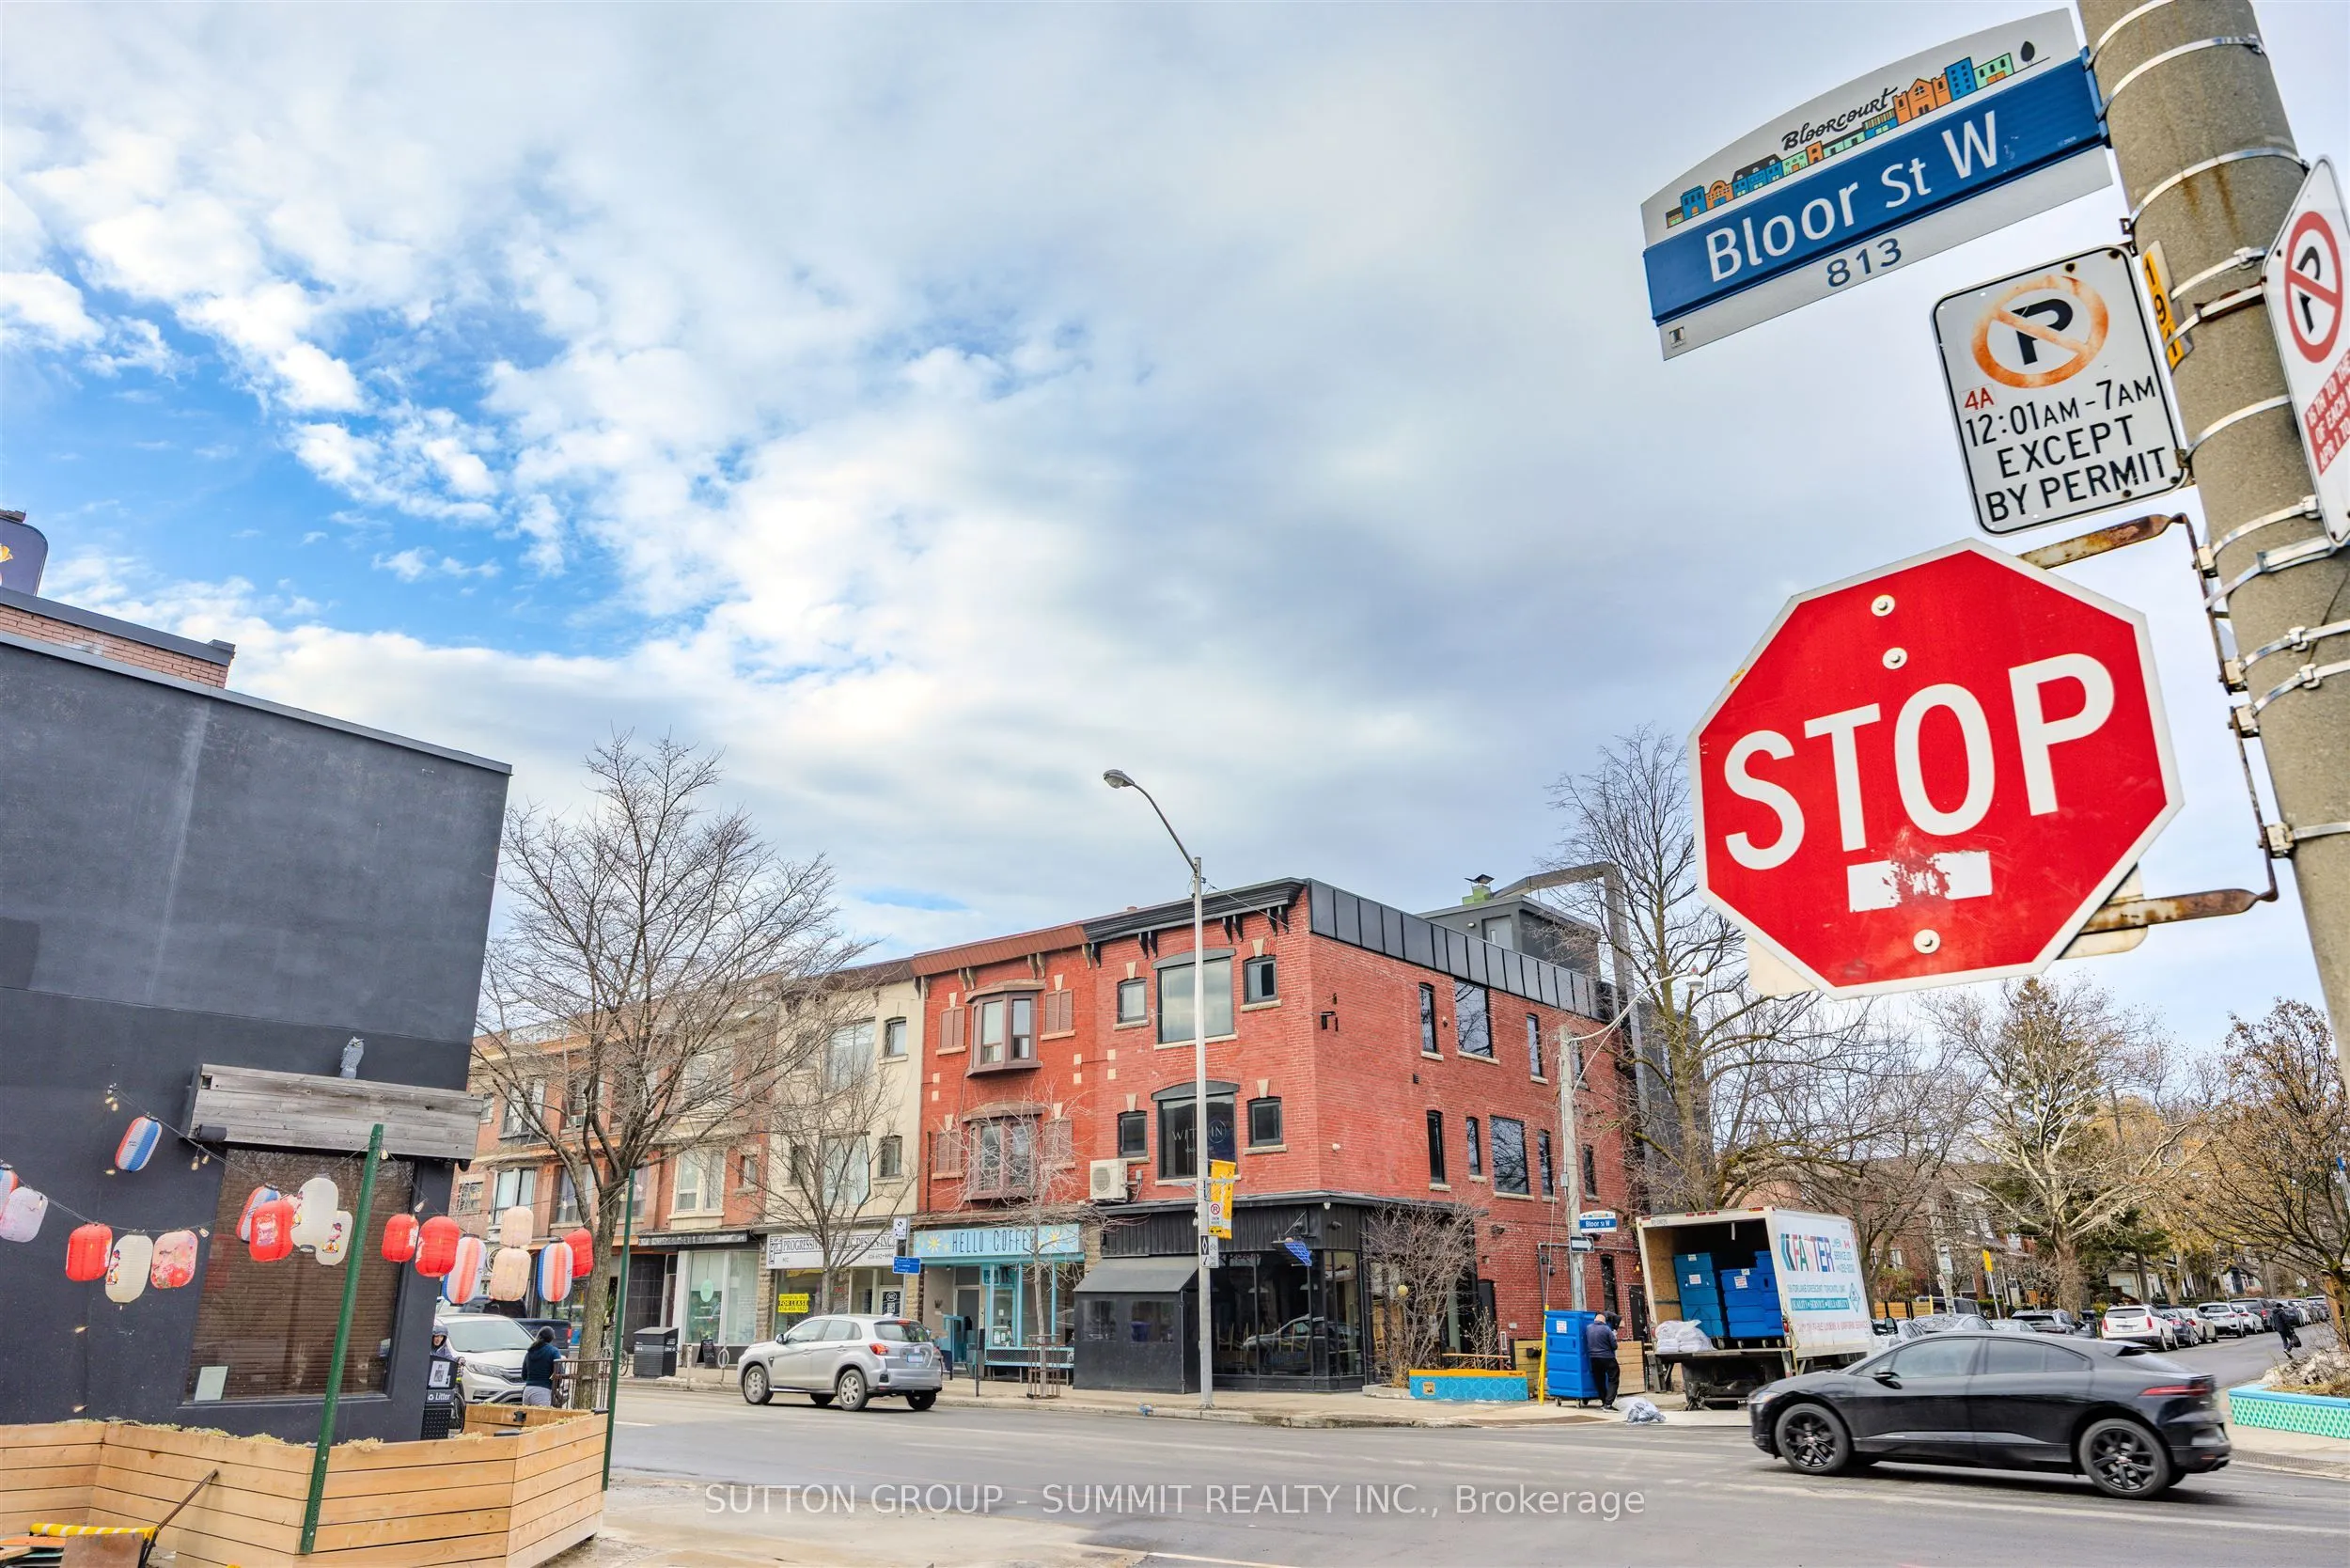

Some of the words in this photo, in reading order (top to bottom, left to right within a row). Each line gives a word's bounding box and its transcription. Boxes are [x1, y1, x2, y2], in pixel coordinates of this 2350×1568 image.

[1781, 86, 1898, 151] Bloorcourt
[1706, 181, 1858, 282] Bloor
[1881, 157, 1932, 208] St
[1941, 110, 1998, 180] W
[1826, 237, 1903, 287] 813
[1964, 386, 1995, 411] 4A
[1997, 414, 2135, 479] EXCEPT
[1985, 484, 2028, 523] BY
[2039, 447, 2166, 510] PERMIT
[1724, 652, 2115, 870] STOP
[952, 1231, 984, 1253] HELLO
[993, 1229, 1034, 1252] COFFEE
[435, 1392, 450, 1401] Litter
